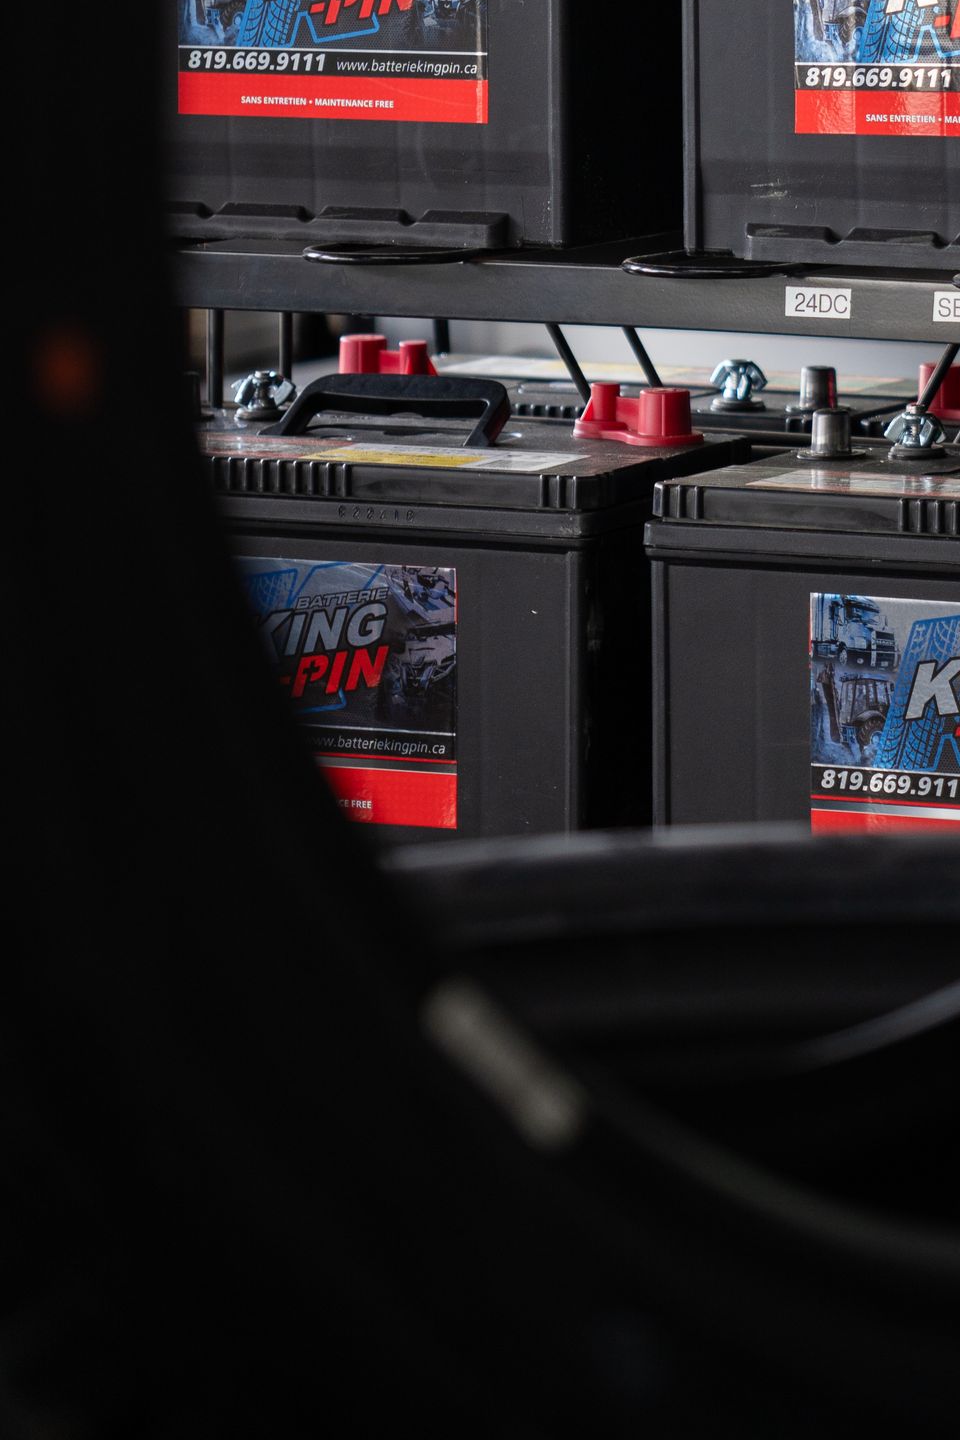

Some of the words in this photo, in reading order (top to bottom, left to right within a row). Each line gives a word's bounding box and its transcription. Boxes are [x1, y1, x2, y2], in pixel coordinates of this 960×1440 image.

[188, 51, 326, 72] 819.669.9111
[336, 59, 478, 76] www.batteriekingpin.ca
[805, 67, 951, 88] 819.669.9111
[240, 95, 262, 105] SANS
[263, 96, 306, 106] ENTRETIEN
[314, 98, 372, 108] MAINTENANCE
[374, 99, 394, 109] FREE
[865, 113, 888, 123] SANS
[889, 114, 935, 124] ENTRETIEN
[795, 292, 848, 314] 24DC
[296, 587, 389, 610] BATTERIE
[351, 799, 372, 810] FREE
